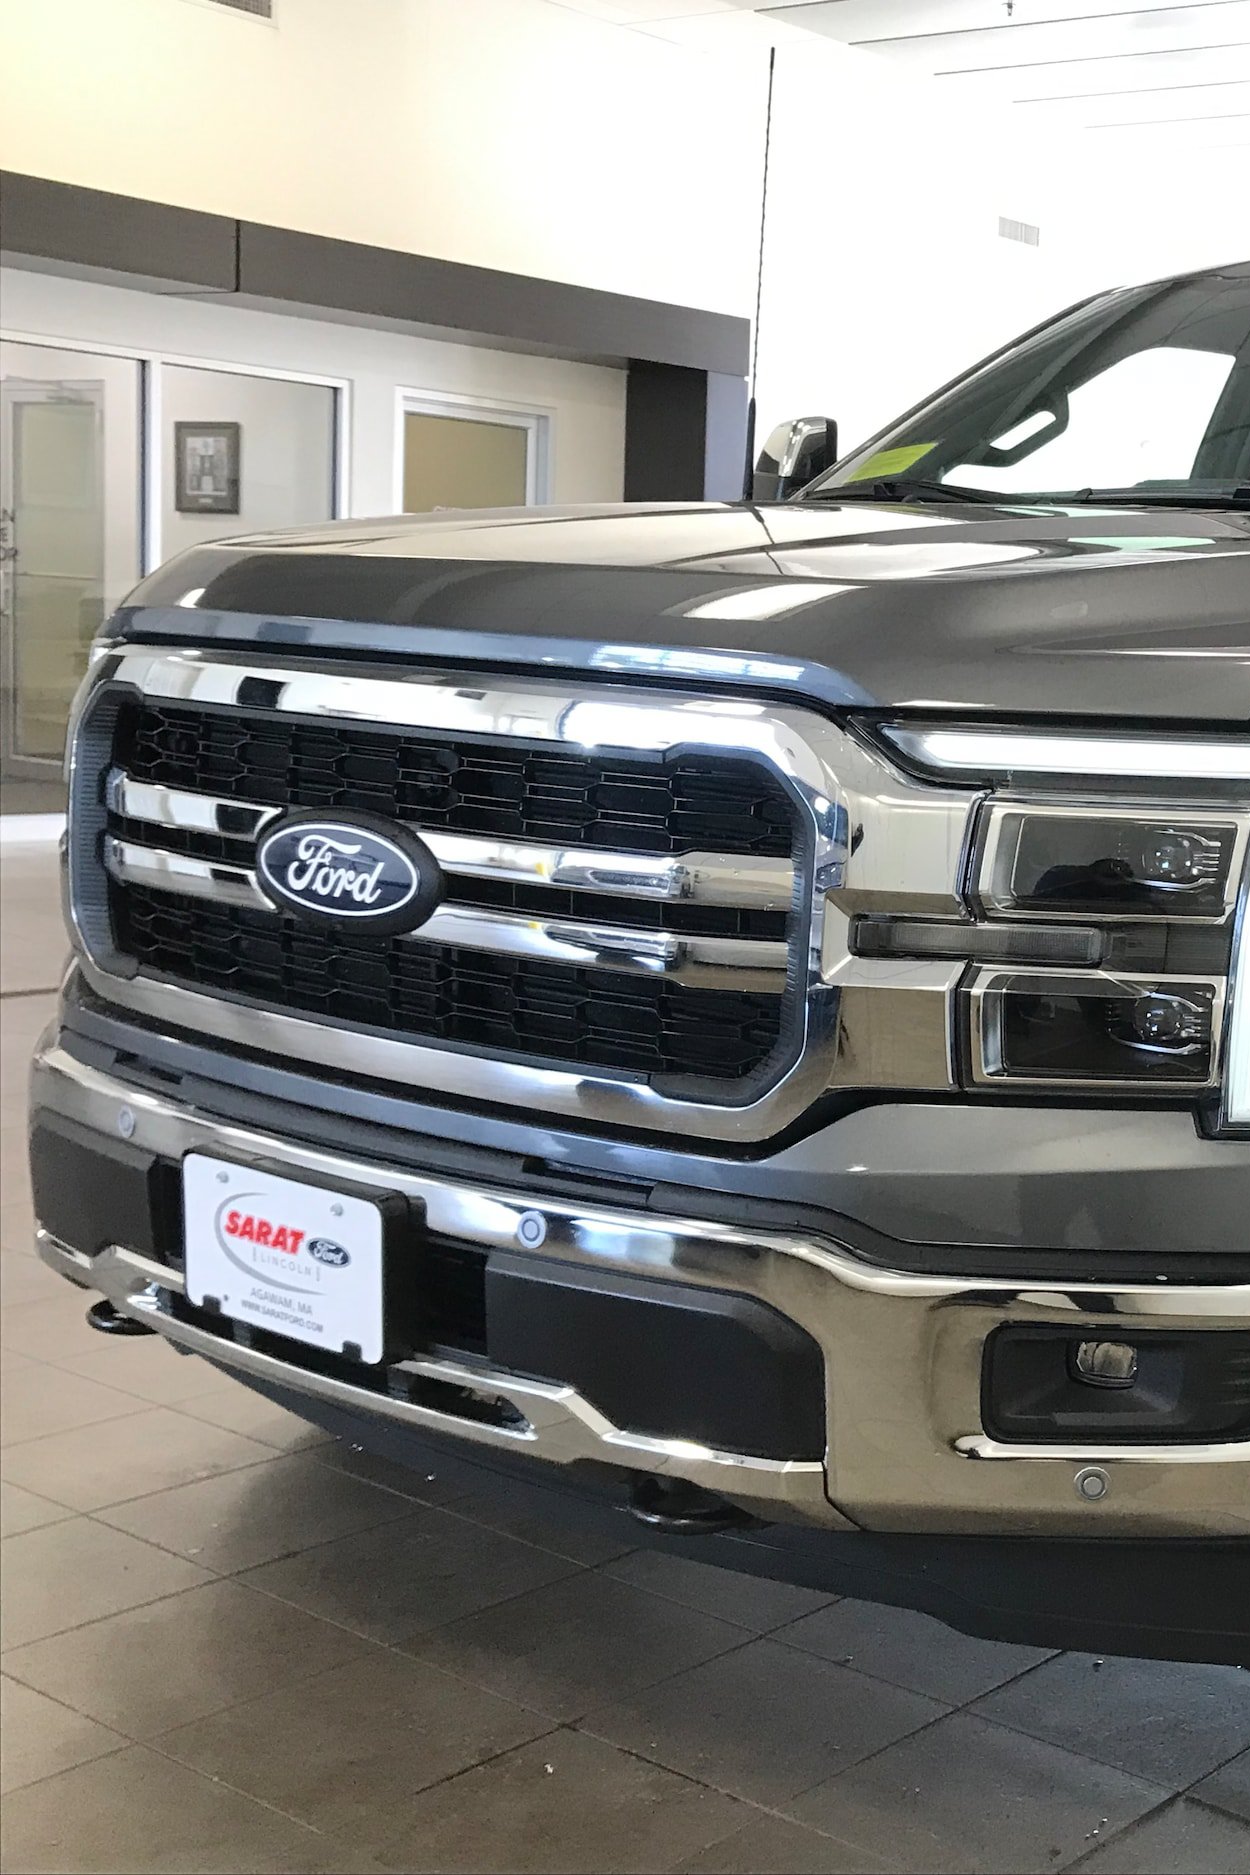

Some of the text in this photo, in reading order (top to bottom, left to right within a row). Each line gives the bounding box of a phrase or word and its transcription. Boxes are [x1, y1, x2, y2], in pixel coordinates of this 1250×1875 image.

[288, 834, 385, 904] Ford
[225, 1209, 305, 1255] SARAT
[313, 1241, 344, 1265] Ford
[297, 1301, 313, 1315] MA
